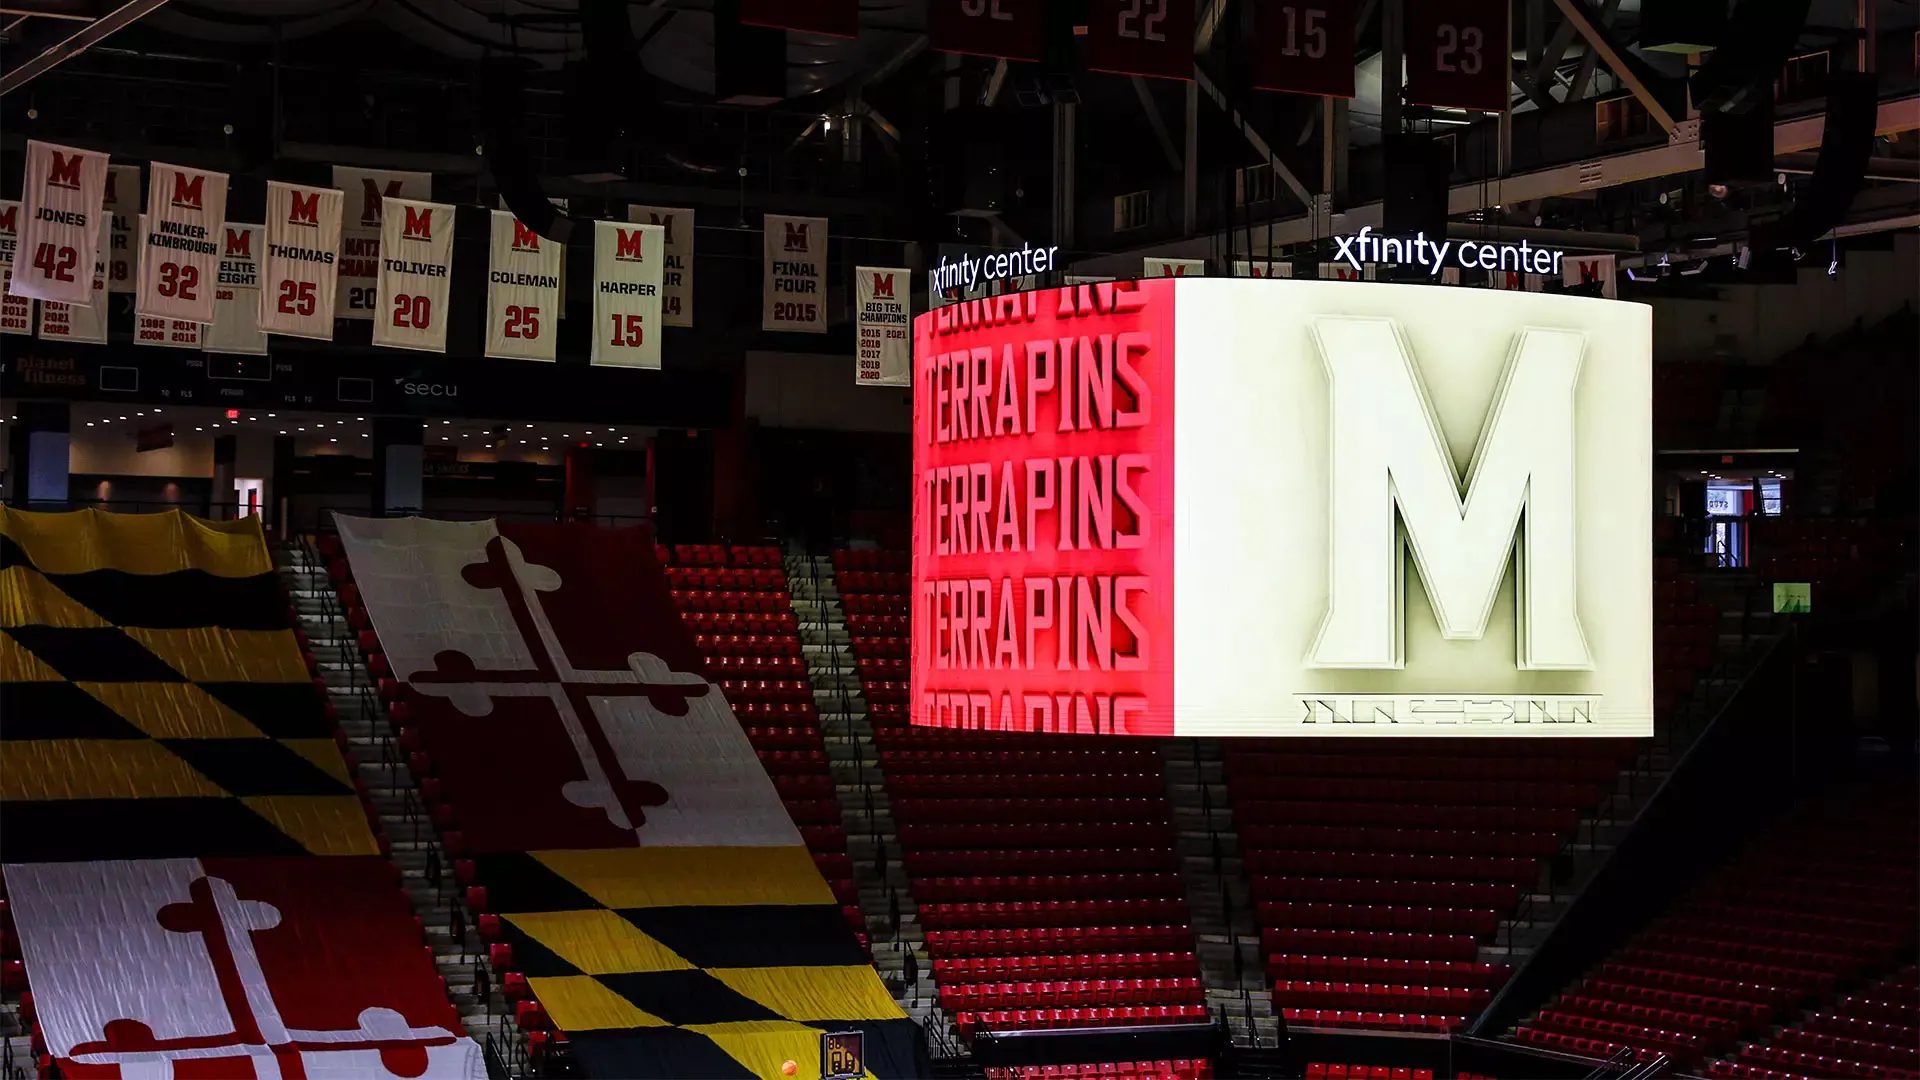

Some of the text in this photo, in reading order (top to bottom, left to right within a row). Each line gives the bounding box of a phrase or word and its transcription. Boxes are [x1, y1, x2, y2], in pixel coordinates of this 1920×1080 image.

[1118, 0, 1167, 42] 22
[1281, 6, 1327, 59] 15
[1436, 23, 1484, 75] 23
[49, 151, 84, 186] M
[172, 172, 205, 206] M
[35, 207, 86, 227] JONES
[289, 190, 320, 224] M
[160, 220, 208, 240] WALKER-
[403, 206, 433, 238] M
[148, 232, 217, 255] KIMBROUGH
[225, 229, 251, 256] M
[616, 228, 643, 259] M
[784, 222, 809, 249] M
[34, 242, 77, 282] 42
[268, 243, 334, 264] THOMAS
[1333, 226, 1564, 275] xfinity center
[220, 260, 256, 273] ELITE
[384, 258, 446, 277] TOLIVER
[772, 261, 819, 277] FINAL
[933, 241, 1058, 298] xfinity center
[158, 262, 199, 300] 32
[218, 272, 256, 285] EIGHT
[491, 271, 558, 288] COLEMAN
[600, 281, 656, 296] HARPER
[775, 278, 816, 293] FOUR
[873, 273, 894, 297] M
[278, 280, 316, 316] 25
[866, 302, 901, 313] BIG TEN
[2, 306, 27, 317] 2012
[44, 312, 69, 323] 2021
[393, 294, 431, 329] 20
[504, 305, 540, 339] 25
[774, 302, 816, 321] 2015
[860, 312, 907, 323] CHAMPIONS
[44, 324, 69, 335] 2022
[611, 314, 643, 347] 15
[861, 328, 906, 339] 2015 2021
[16, 354, 75, 372] planet
[861, 350, 880, 358] 2017
[24, 368, 87, 386] fitness
[861, 371, 880, 379] 2020
[404, 381, 458, 397] secu
[925, 331, 1151, 446] TERRAPINS
[1302, 313, 1596, 672] M
[924, 454, 1151, 556] TERRAPINS
[923, 575, 1150, 672] TERRAPINS
